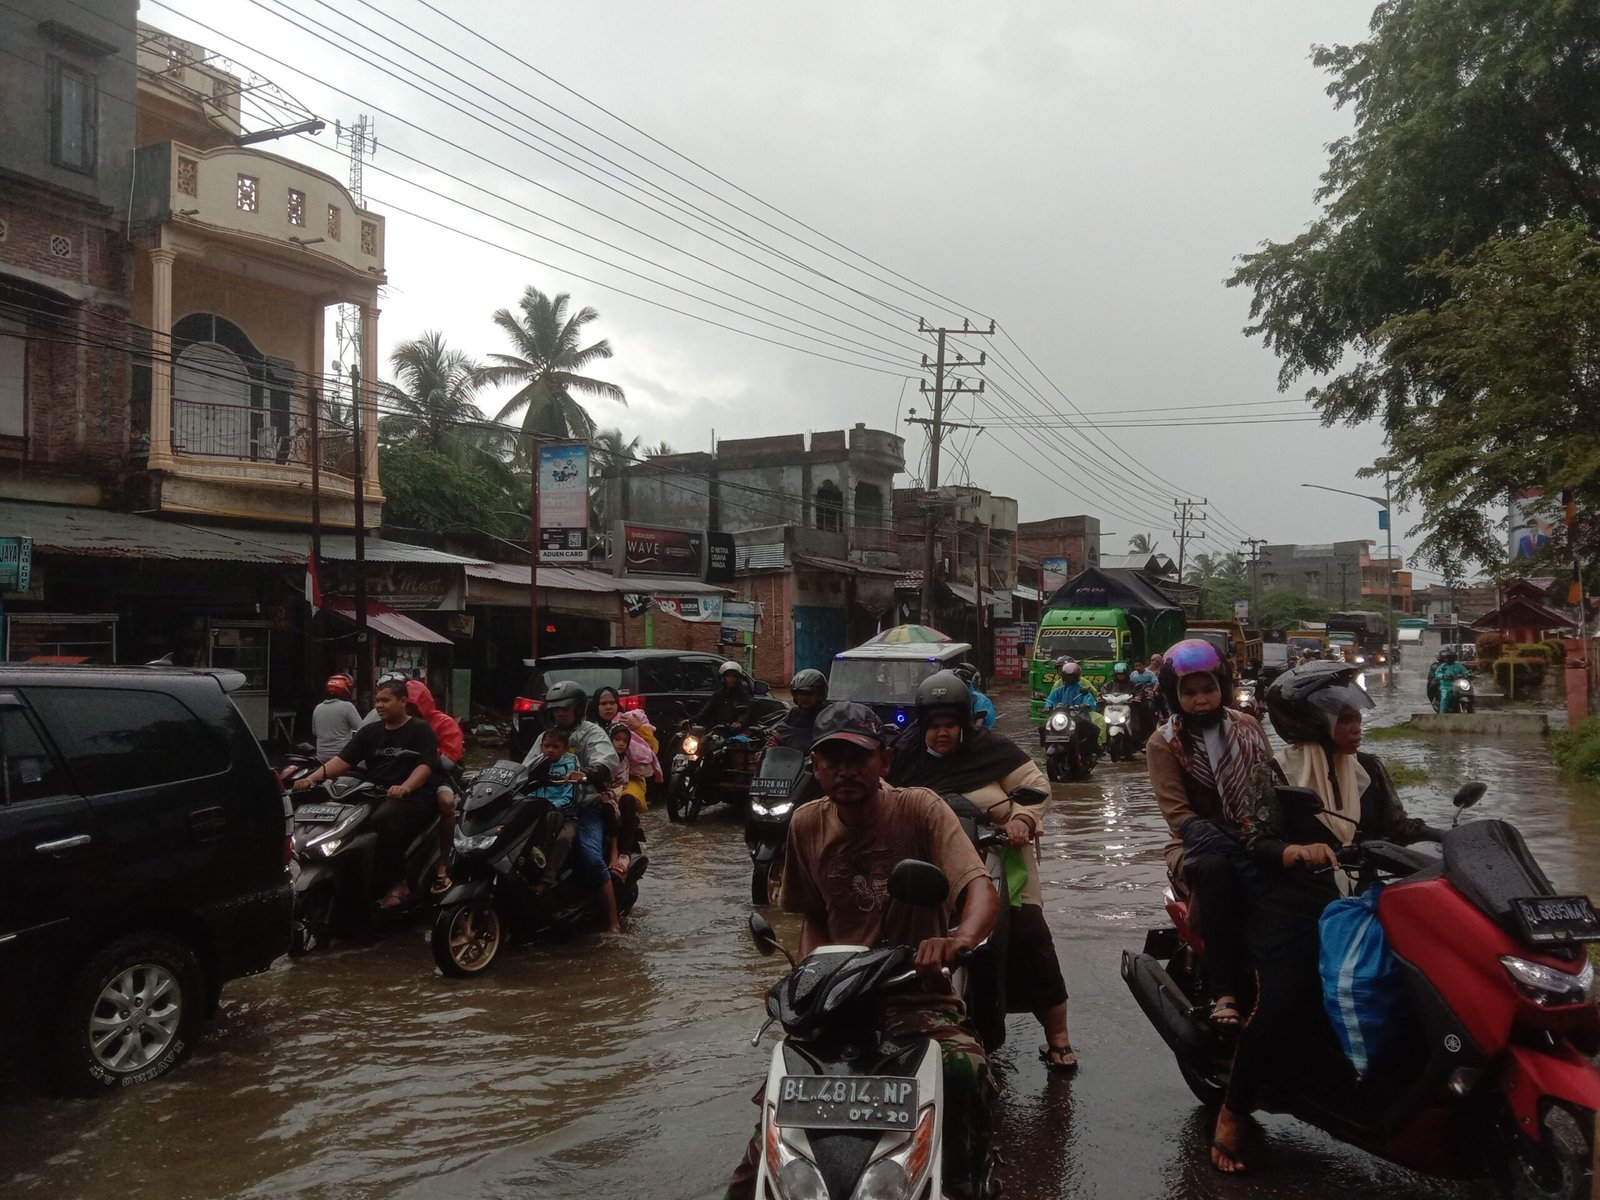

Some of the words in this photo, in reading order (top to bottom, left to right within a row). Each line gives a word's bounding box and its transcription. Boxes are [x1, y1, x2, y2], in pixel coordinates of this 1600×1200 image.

[627, 540, 660, 555] WAVE
[1521, 904, 1541, 921] BL
[122, 1040, 184, 1086] SAVERO
[784, 1080, 809, 1102] BL
[818, 1080, 871, 1103] 4814
[883, 1082, 912, 1105] NP
